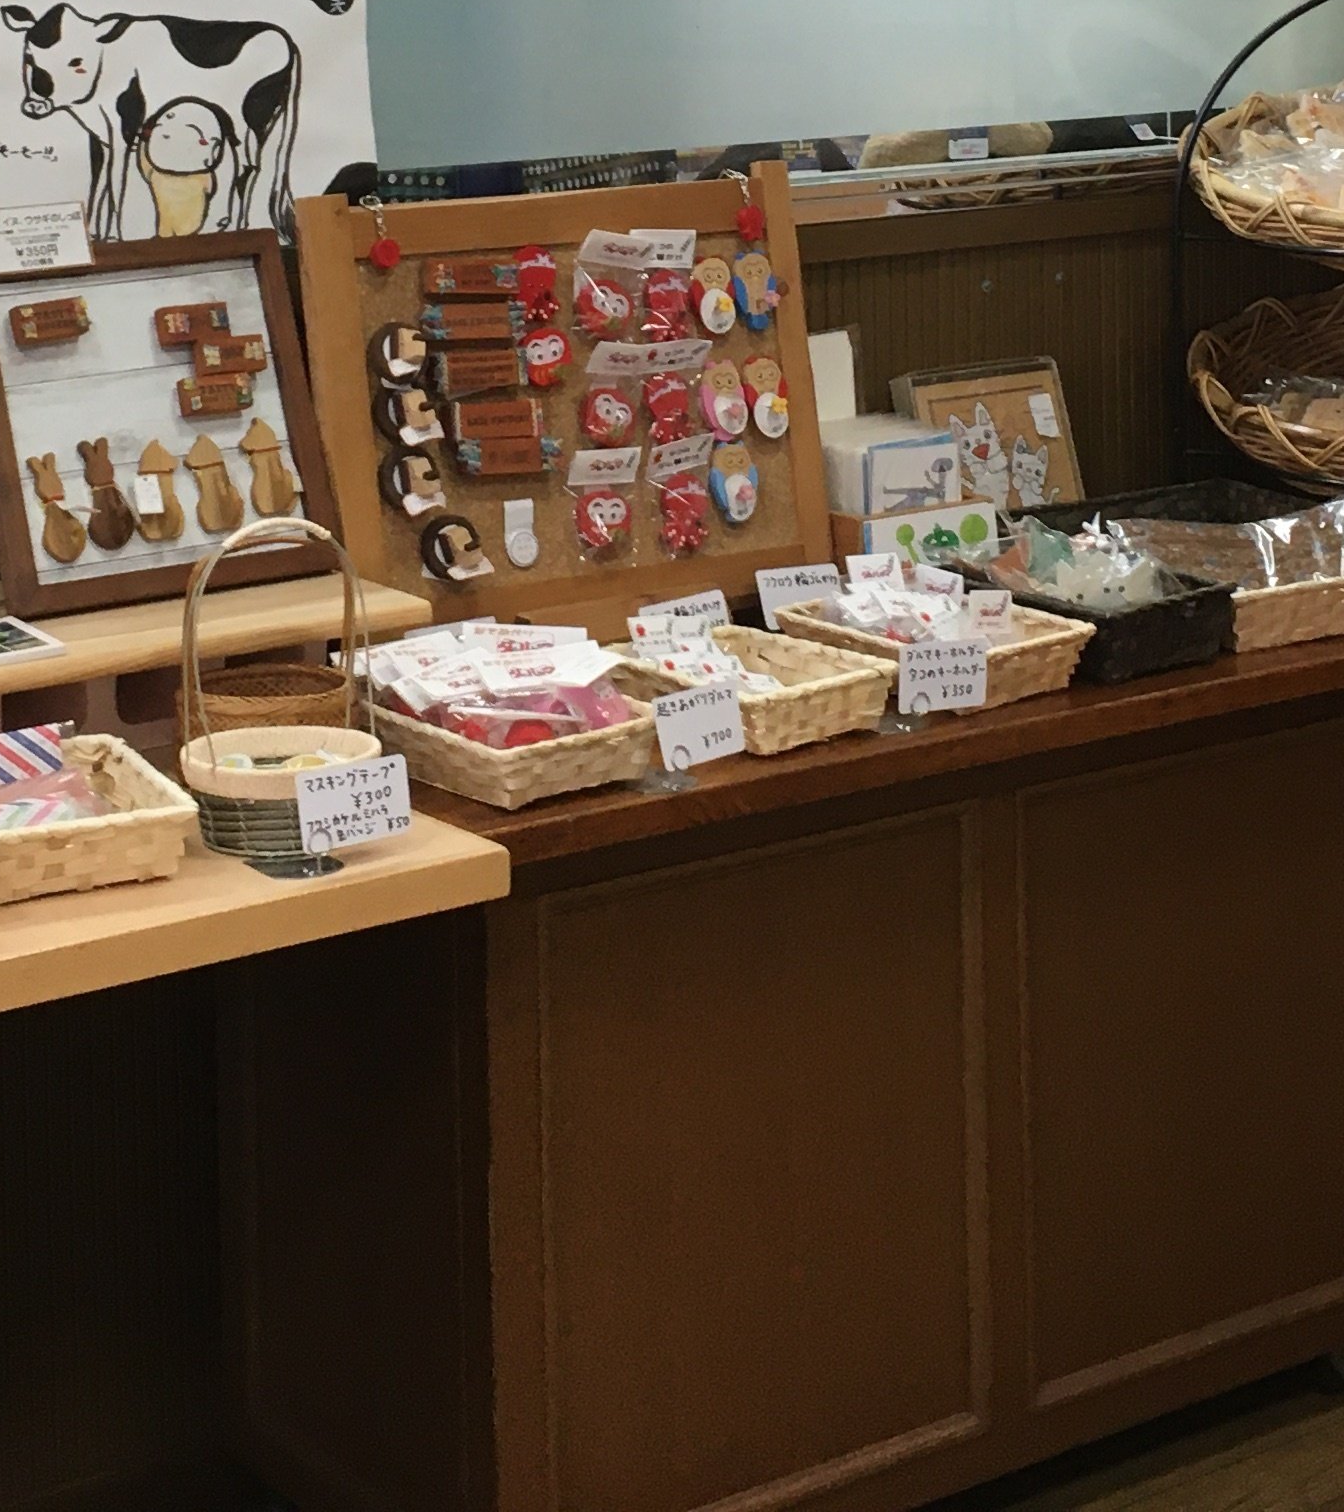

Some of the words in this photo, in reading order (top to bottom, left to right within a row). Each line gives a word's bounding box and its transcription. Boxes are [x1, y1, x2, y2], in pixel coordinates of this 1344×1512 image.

[304, 762, 396, 793] マスキングテープ
[350, 785, 392, 809] ¥300
